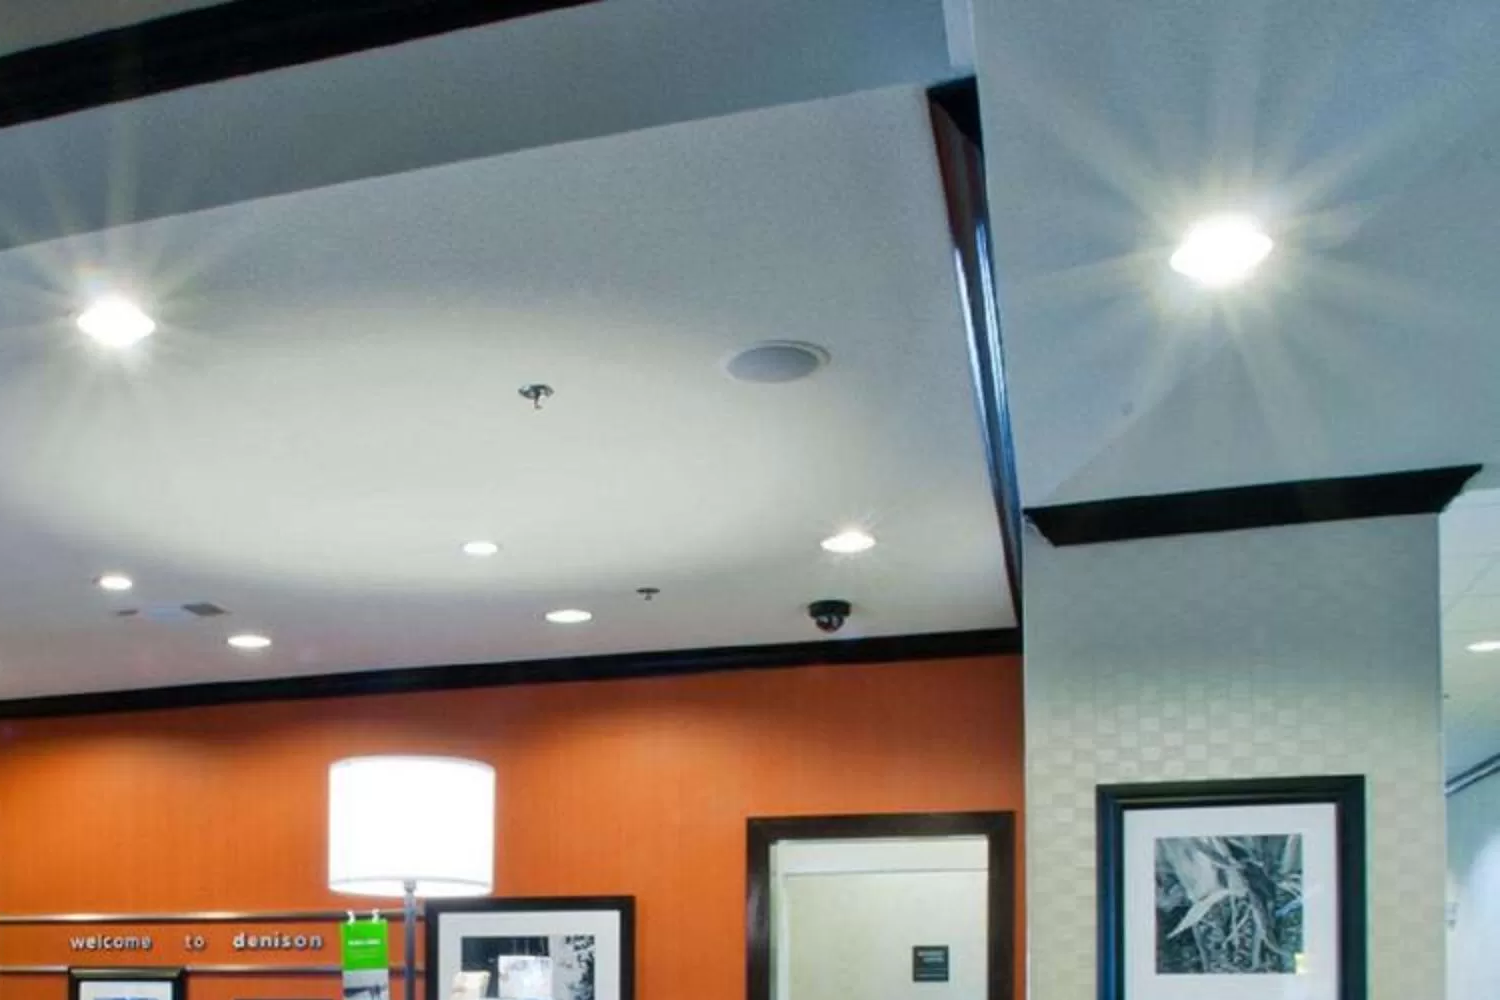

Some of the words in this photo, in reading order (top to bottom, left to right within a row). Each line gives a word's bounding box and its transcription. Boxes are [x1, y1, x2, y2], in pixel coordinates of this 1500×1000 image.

[69, 935, 153, 950] welcome
[184, 934, 206, 949] to
[232, 932, 324, 950] denison
